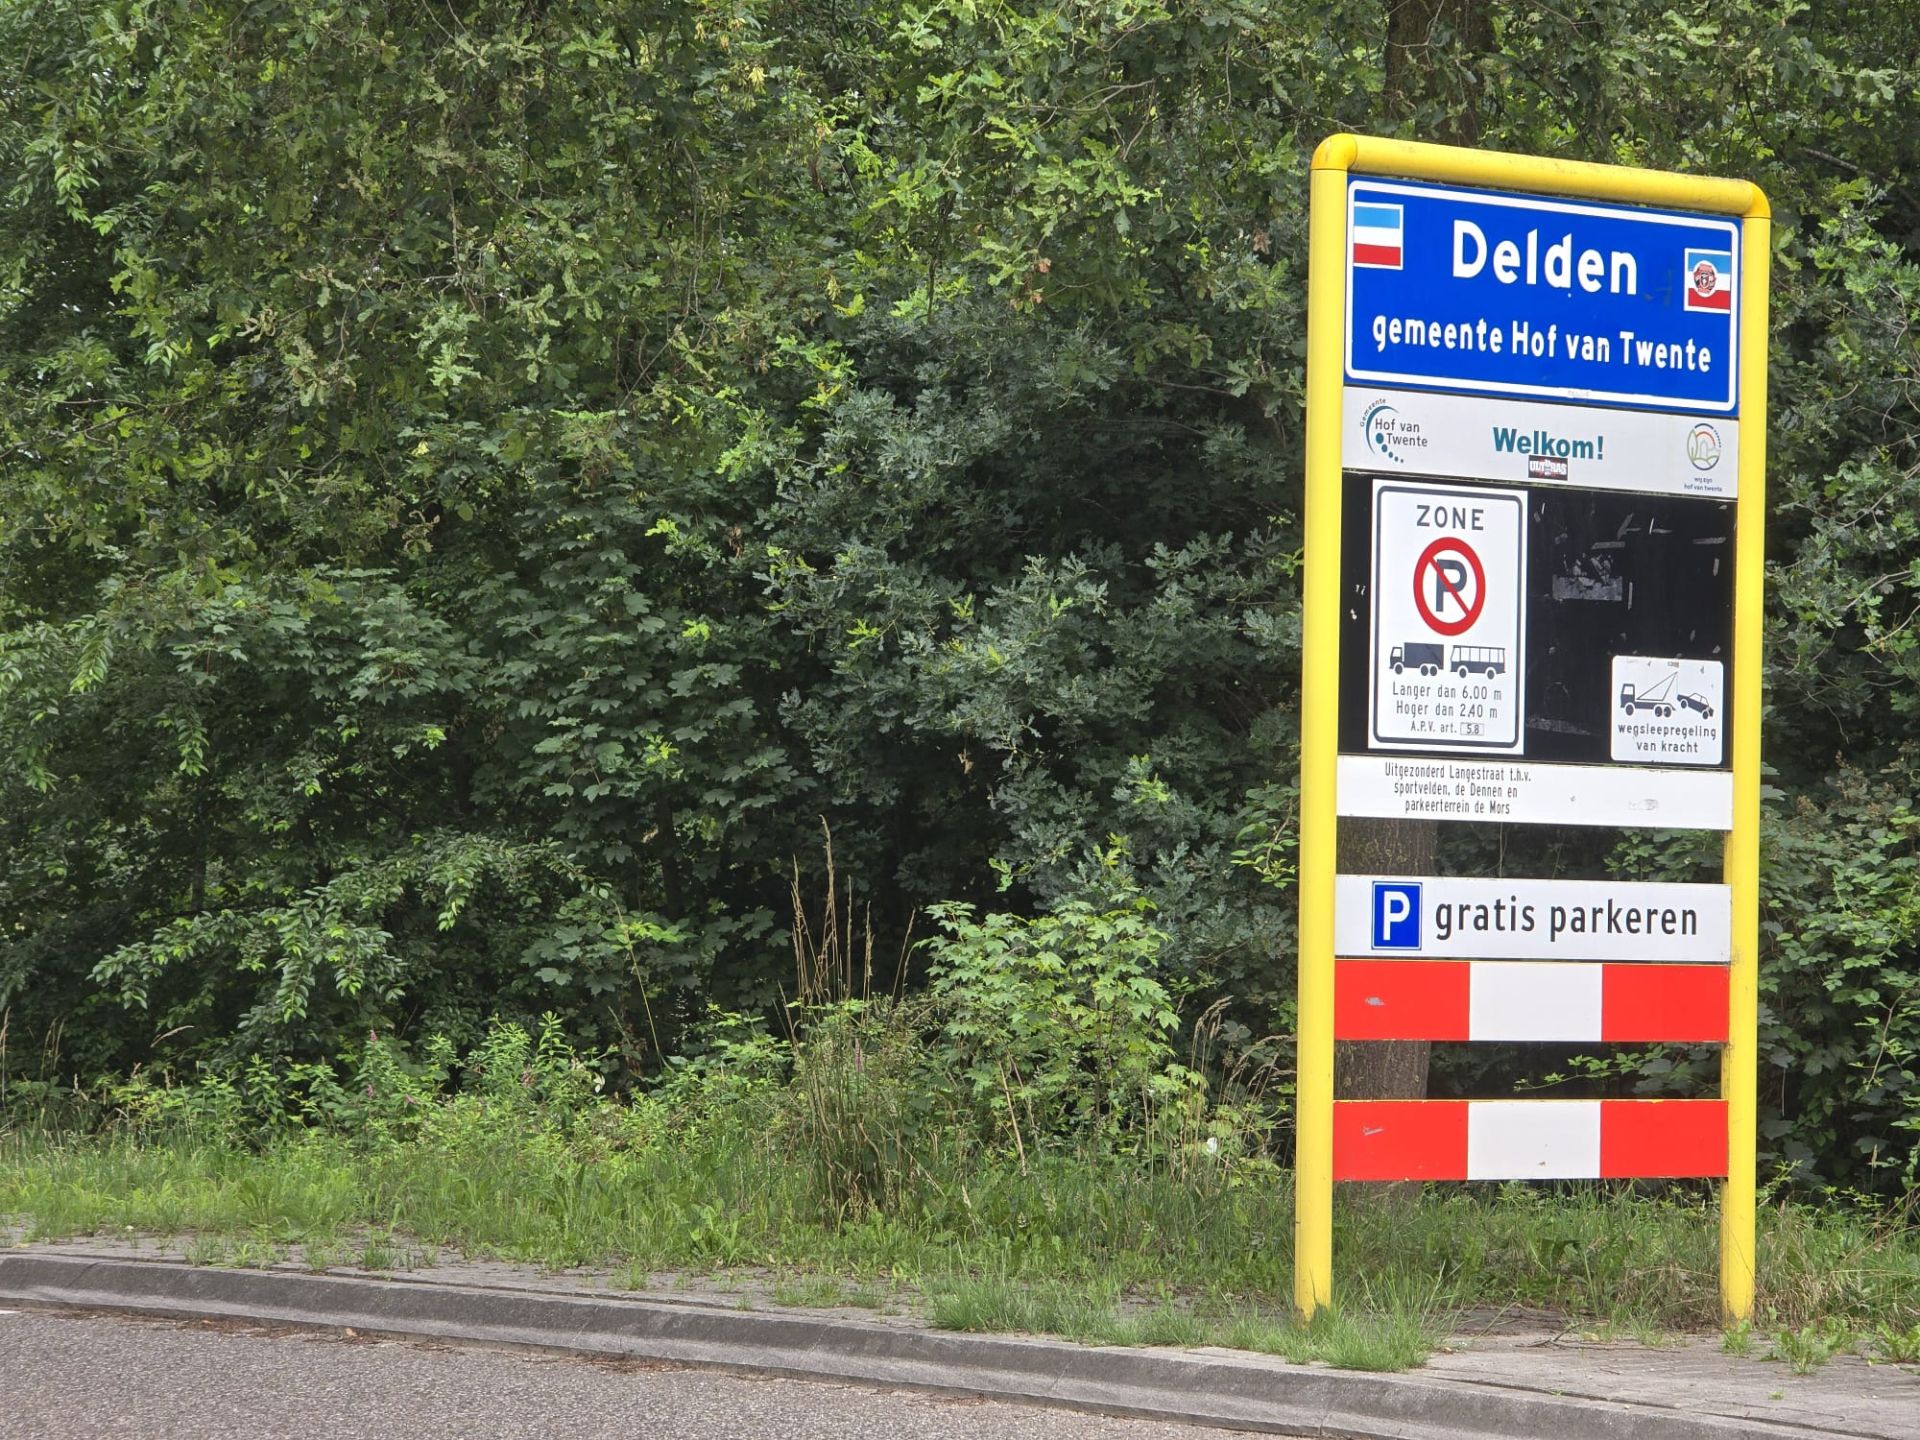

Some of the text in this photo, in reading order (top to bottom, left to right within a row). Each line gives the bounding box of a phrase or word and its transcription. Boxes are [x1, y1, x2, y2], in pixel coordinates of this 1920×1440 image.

[1452, 219, 1637, 295] Delden
[1373, 315, 1711, 373] gemeente Hof van Twente
[1360, 398, 1387, 428] Gemeente
[1375, 418, 1420, 433] Hof van
[1386, 433, 1428, 447] Twente
[1493, 427, 1604, 459] Welkom!
[1416, 504, 1484, 531] ZONE
[1436, 558, 1467, 612] P
[1392, 681, 1431, 700] Langer
[1437, 684, 1456, 698] dan
[1493, 689, 1501, 700] m
[1396, 700, 1429, 718] Hoger
[1435, 703, 1453, 716] dan
[1489, 707, 1498, 718] m
[1411, 720, 1436, 733] A.P.V.
[1440, 723, 1457, 733] art.
[1618, 723, 1716, 741] wegsleepregeling
[1636, 740, 1698, 753] van kracht
[1385, 761, 1532, 783] Uitgezonderd Langestraat t.h.v.
[1455, 783, 1465, 796] de
[1470, 783, 1502, 797] Dennen
[1507, 786, 1518, 798] en
[1405, 798, 1510, 815] parkeerterrein de Mors
[1383, 891, 1697, 942] P gratis parkeren
